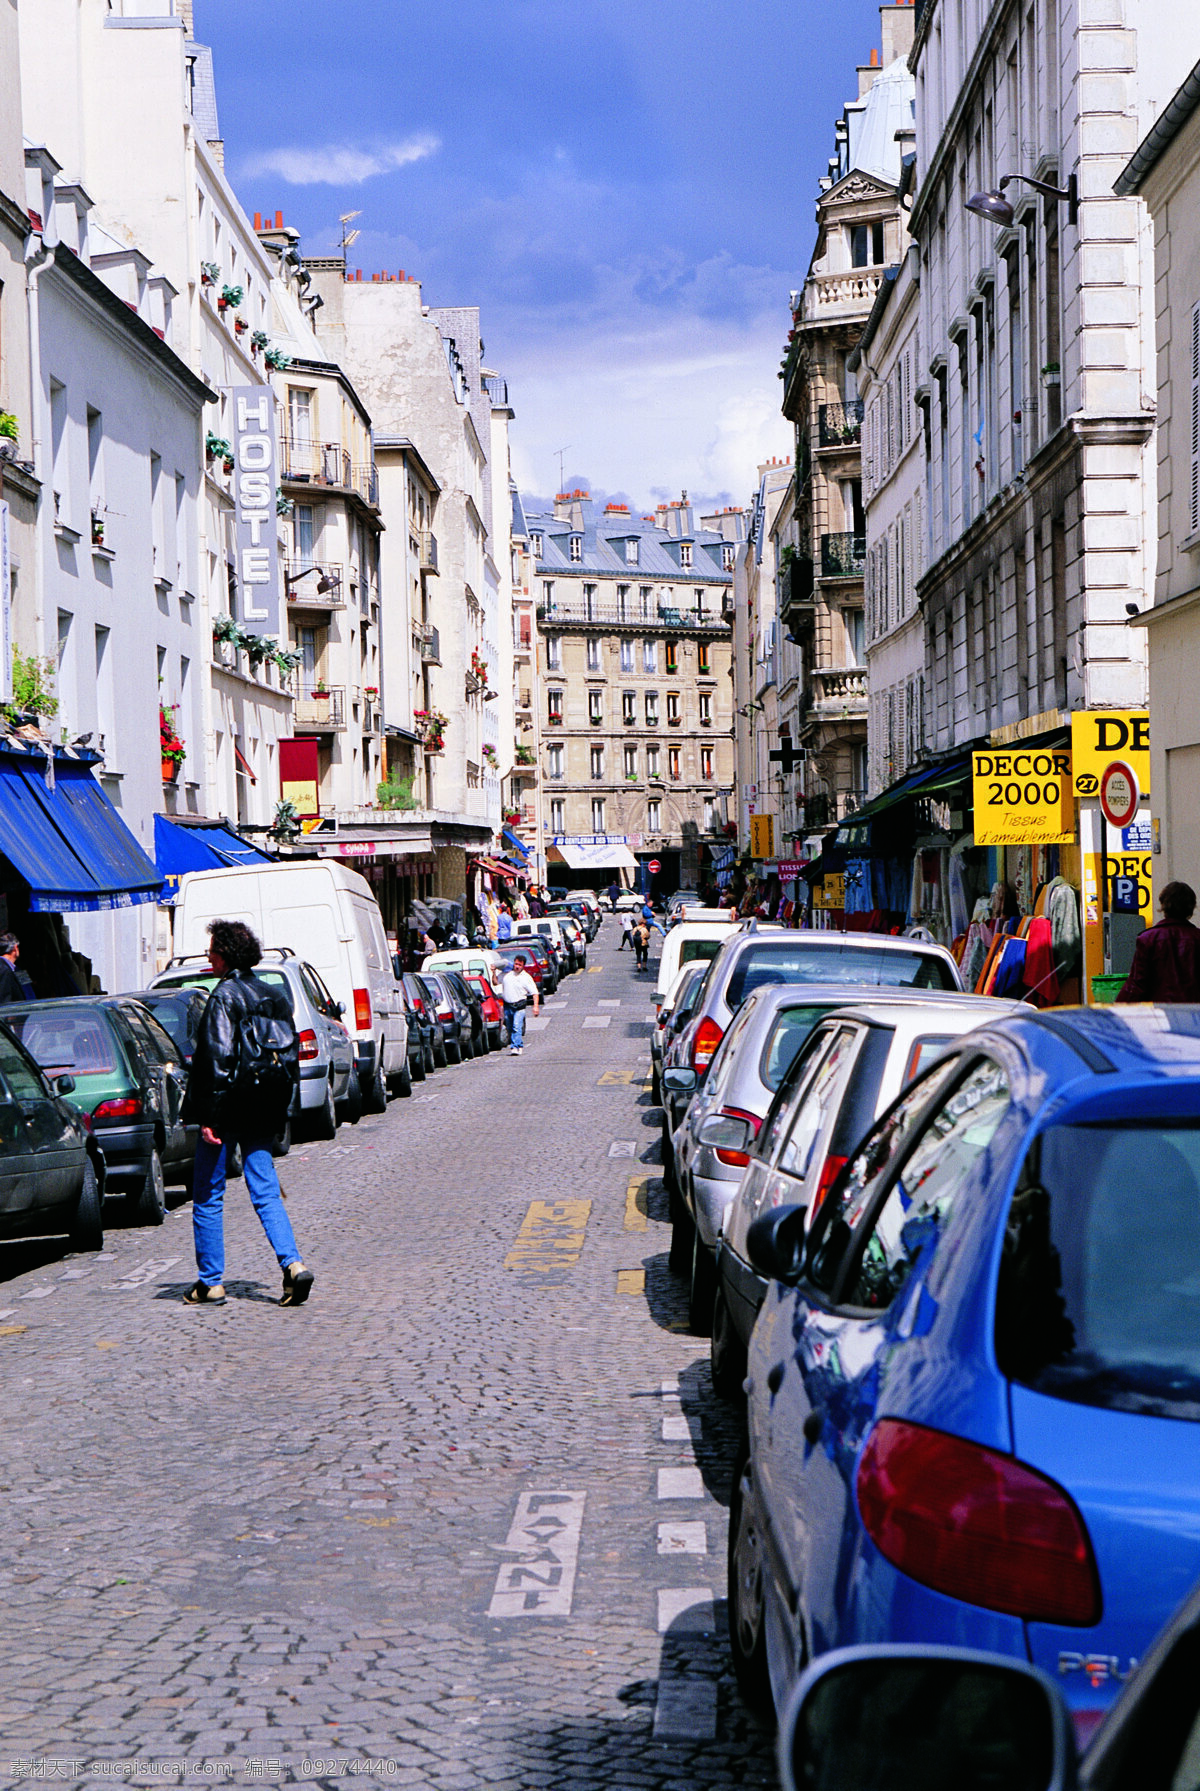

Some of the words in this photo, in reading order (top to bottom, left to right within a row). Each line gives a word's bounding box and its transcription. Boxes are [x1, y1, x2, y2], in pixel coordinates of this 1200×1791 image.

[237, 395, 272, 622] HOSTEL
[1094, 717, 1150, 751] DE
[975, 755, 1072, 776] DECOR
[1077, 777, 1097, 791] 27
[988, 782, 1060, 805] 2000
[1002, 812, 1047, 826] Tissus
[978, 828, 1071, 844] d'ameublement
[345, 843, 369, 854] SYMPA
